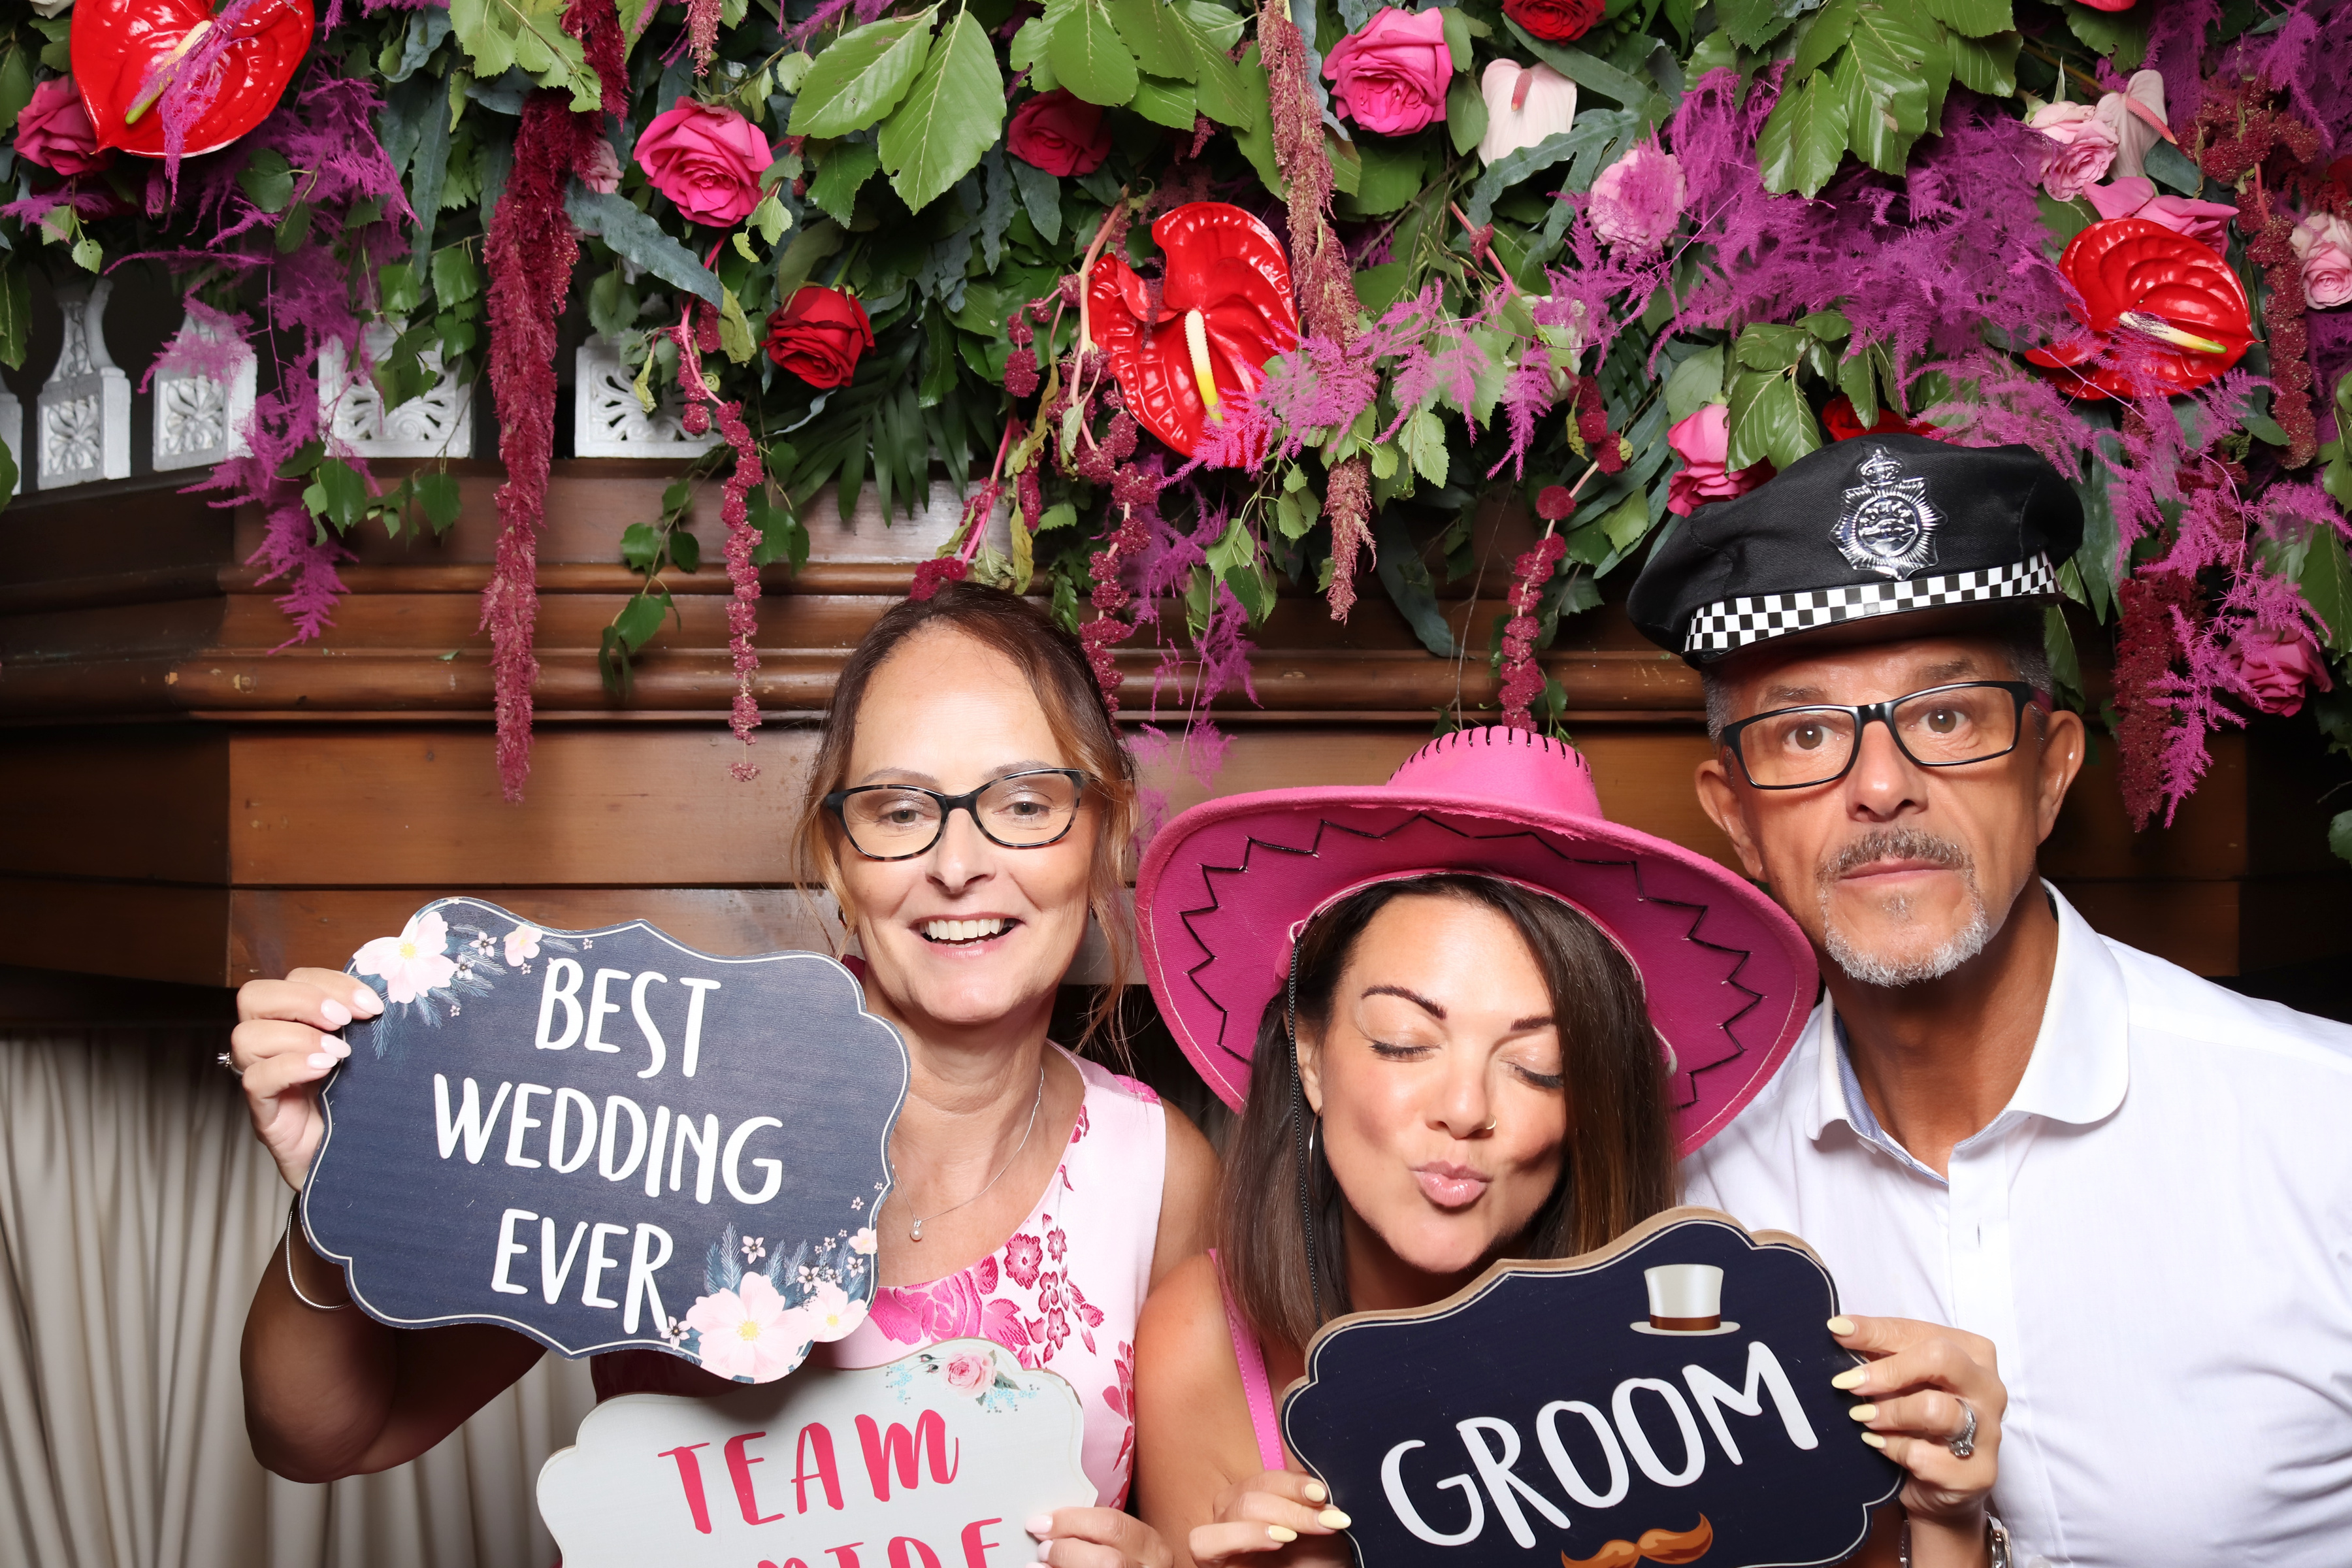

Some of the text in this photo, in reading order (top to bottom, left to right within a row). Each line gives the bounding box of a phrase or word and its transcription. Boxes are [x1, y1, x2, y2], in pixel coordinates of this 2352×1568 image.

[534, 957, 721, 1079] BEST
[433, 1073, 783, 1205] WEDDING
[491, 1208, 675, 1335] EVER
[657, 1409, 959, 1535] TEAM
[1380, 1341, 1819, 1548] GROOM
